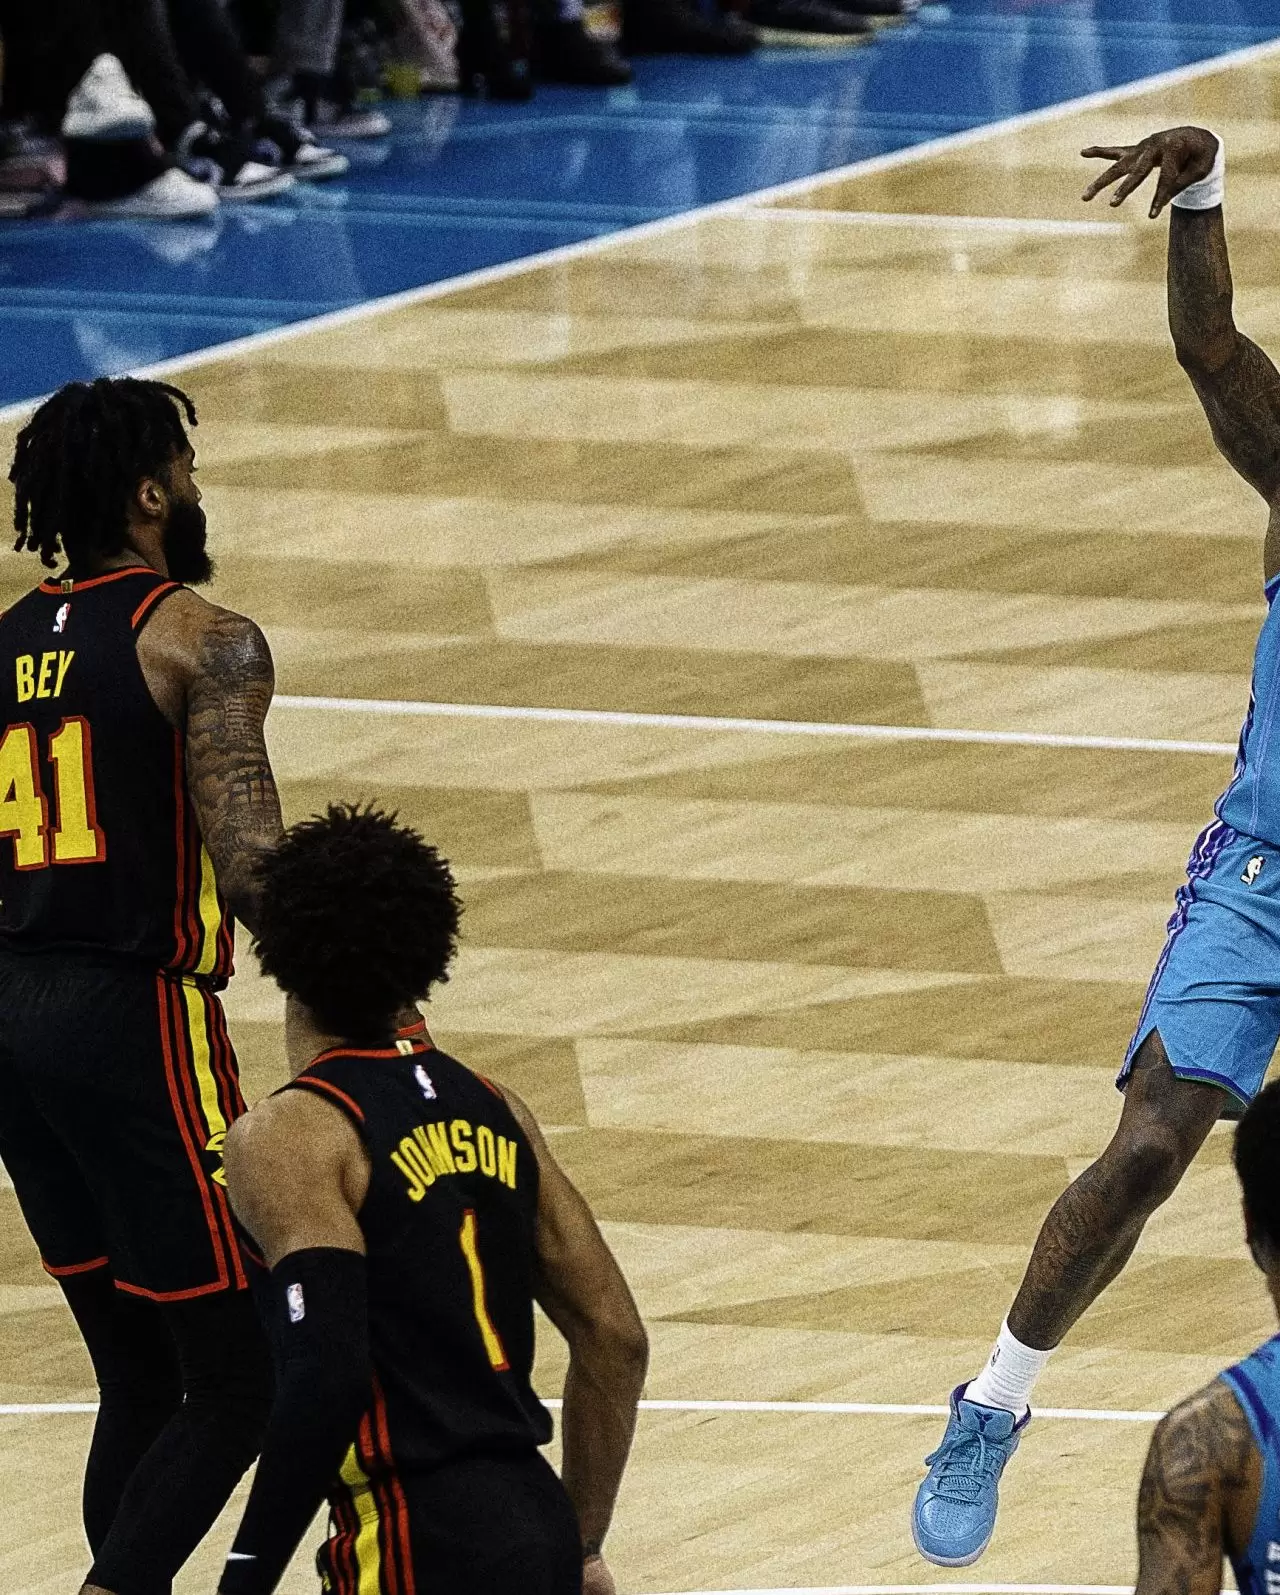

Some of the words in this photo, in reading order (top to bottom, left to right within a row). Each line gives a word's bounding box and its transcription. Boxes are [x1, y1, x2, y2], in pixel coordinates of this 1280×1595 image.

[15, 650, 75, 703] BEY
[0, 715, 106, 871] 41
[459, 1208, 511, 1372] 1
